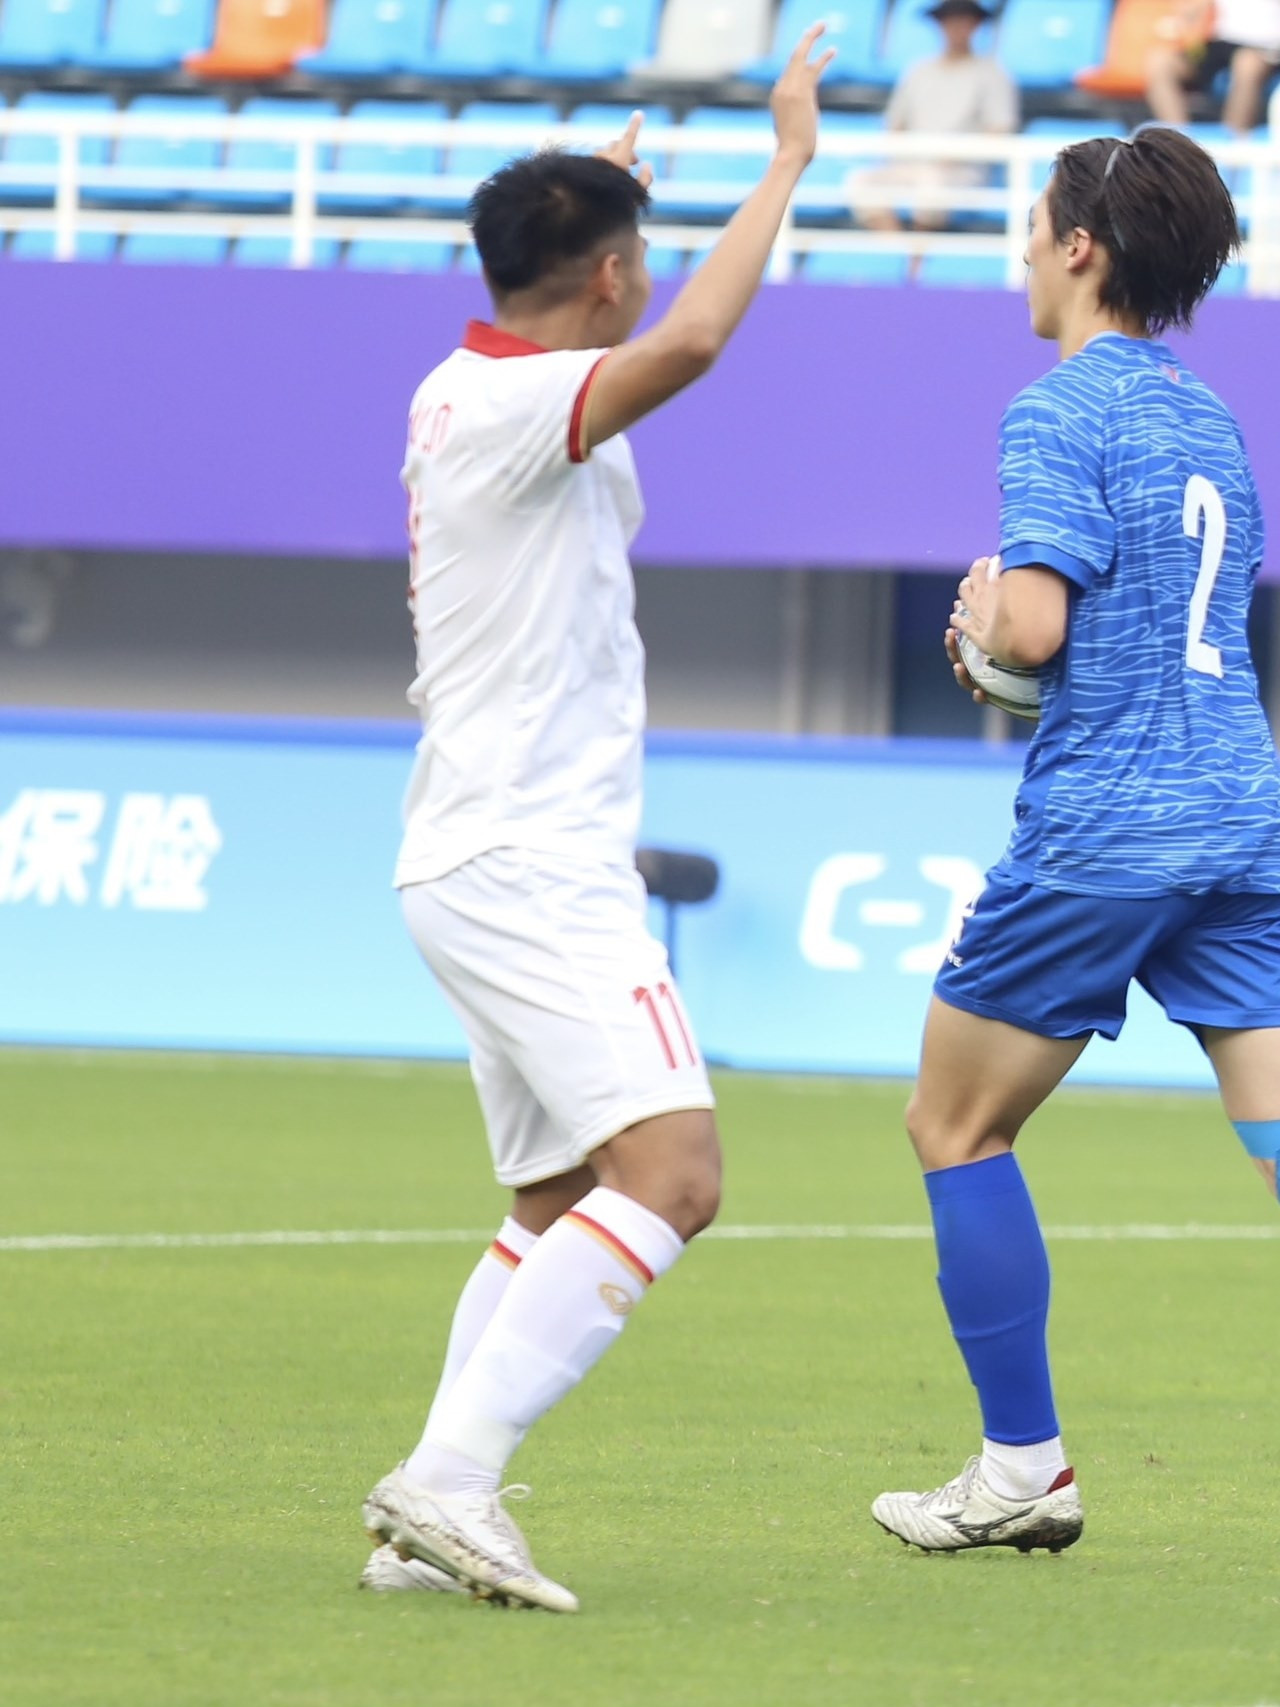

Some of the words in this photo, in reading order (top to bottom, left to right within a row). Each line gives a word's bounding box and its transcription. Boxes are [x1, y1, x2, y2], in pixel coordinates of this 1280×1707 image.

[1182, 474, 1226, 679] 2
[0, 788, 222, 911] 保险
[631, 982, 697, 1070] 11
